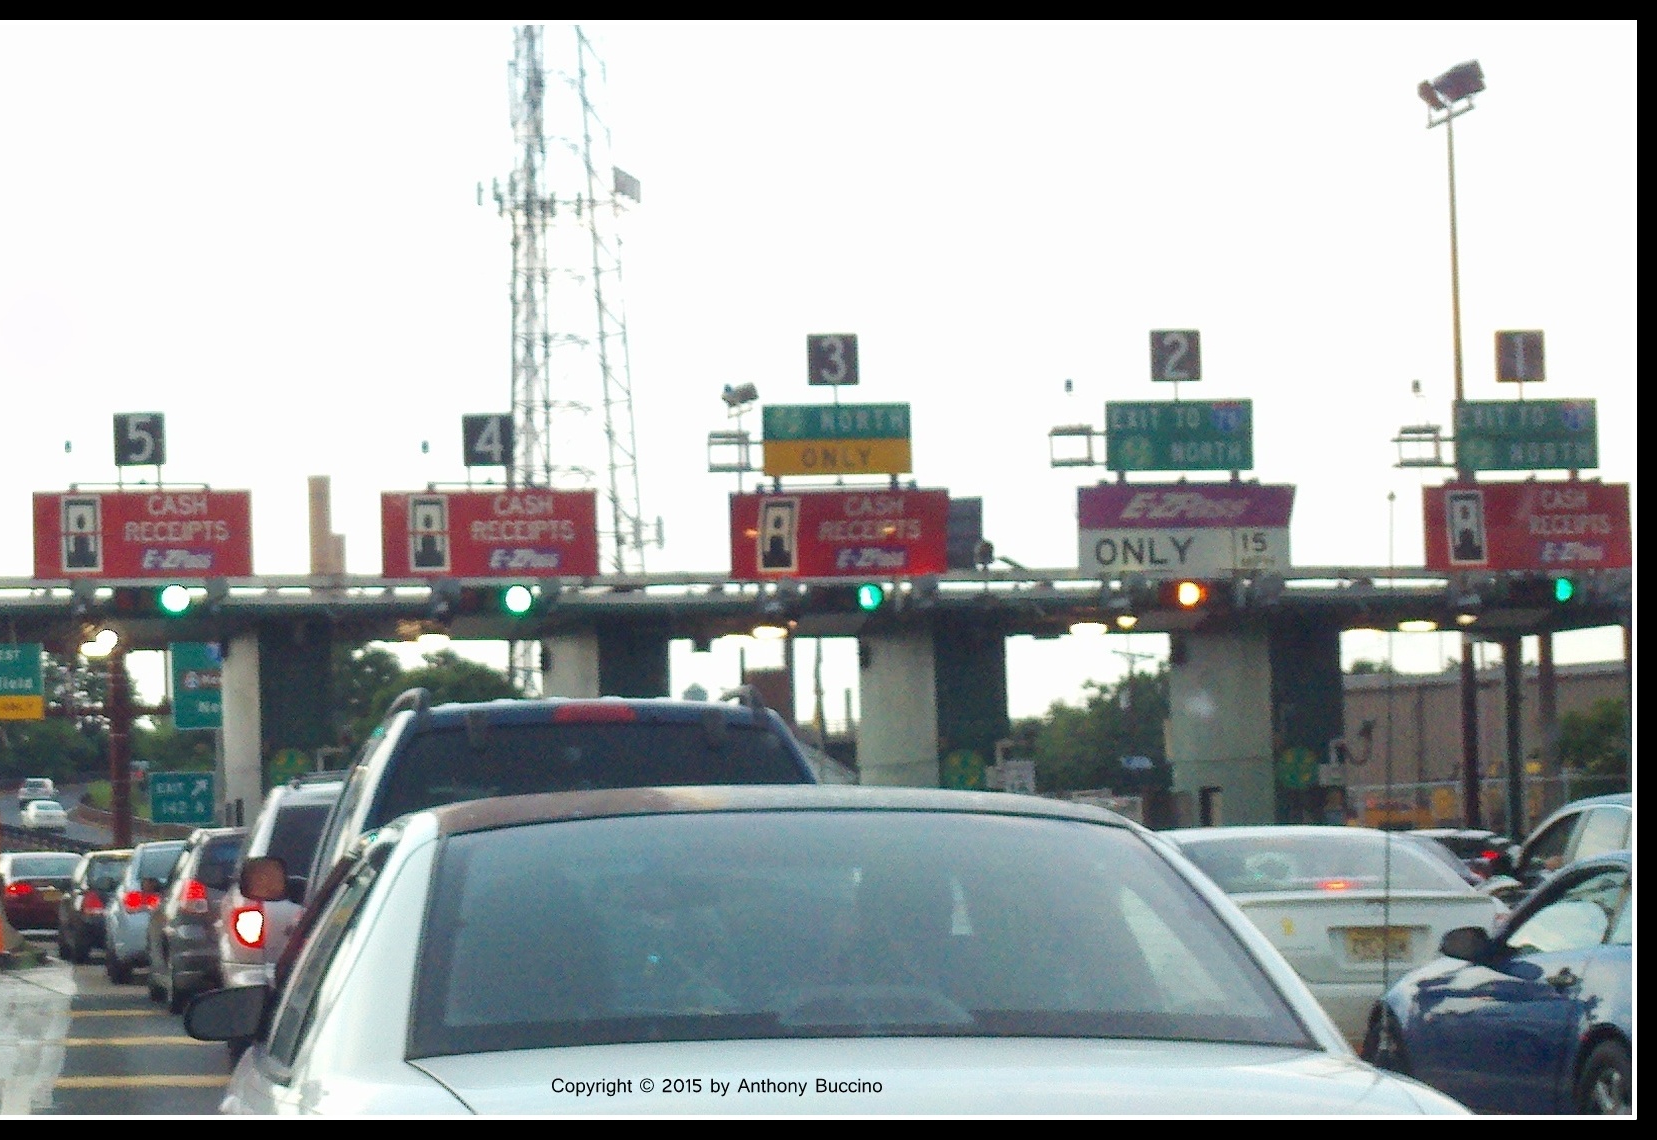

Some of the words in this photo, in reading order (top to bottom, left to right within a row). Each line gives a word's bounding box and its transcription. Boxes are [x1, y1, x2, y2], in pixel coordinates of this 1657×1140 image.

[820, 335, 846, 382] 3
[1162, 332, 1189, 379] 2
[1512, 334, 1526, 378] 1
[127, 416, 154, 461] 5
[475, 416, 504, 461] 4
[800, 447, 872, 470] ONLY
[147, 496, 208, 517] CASH
[493, 494, 554, 516] CASH
[844, 497, 905, 518] CASH
[124, 520, 231, 543] RECEIPTS
[470, 519, 575, 542] RECEIPTS
[1095, 537, 1192, 565] ONLY
[1242, 532, 1268, 552] 15
